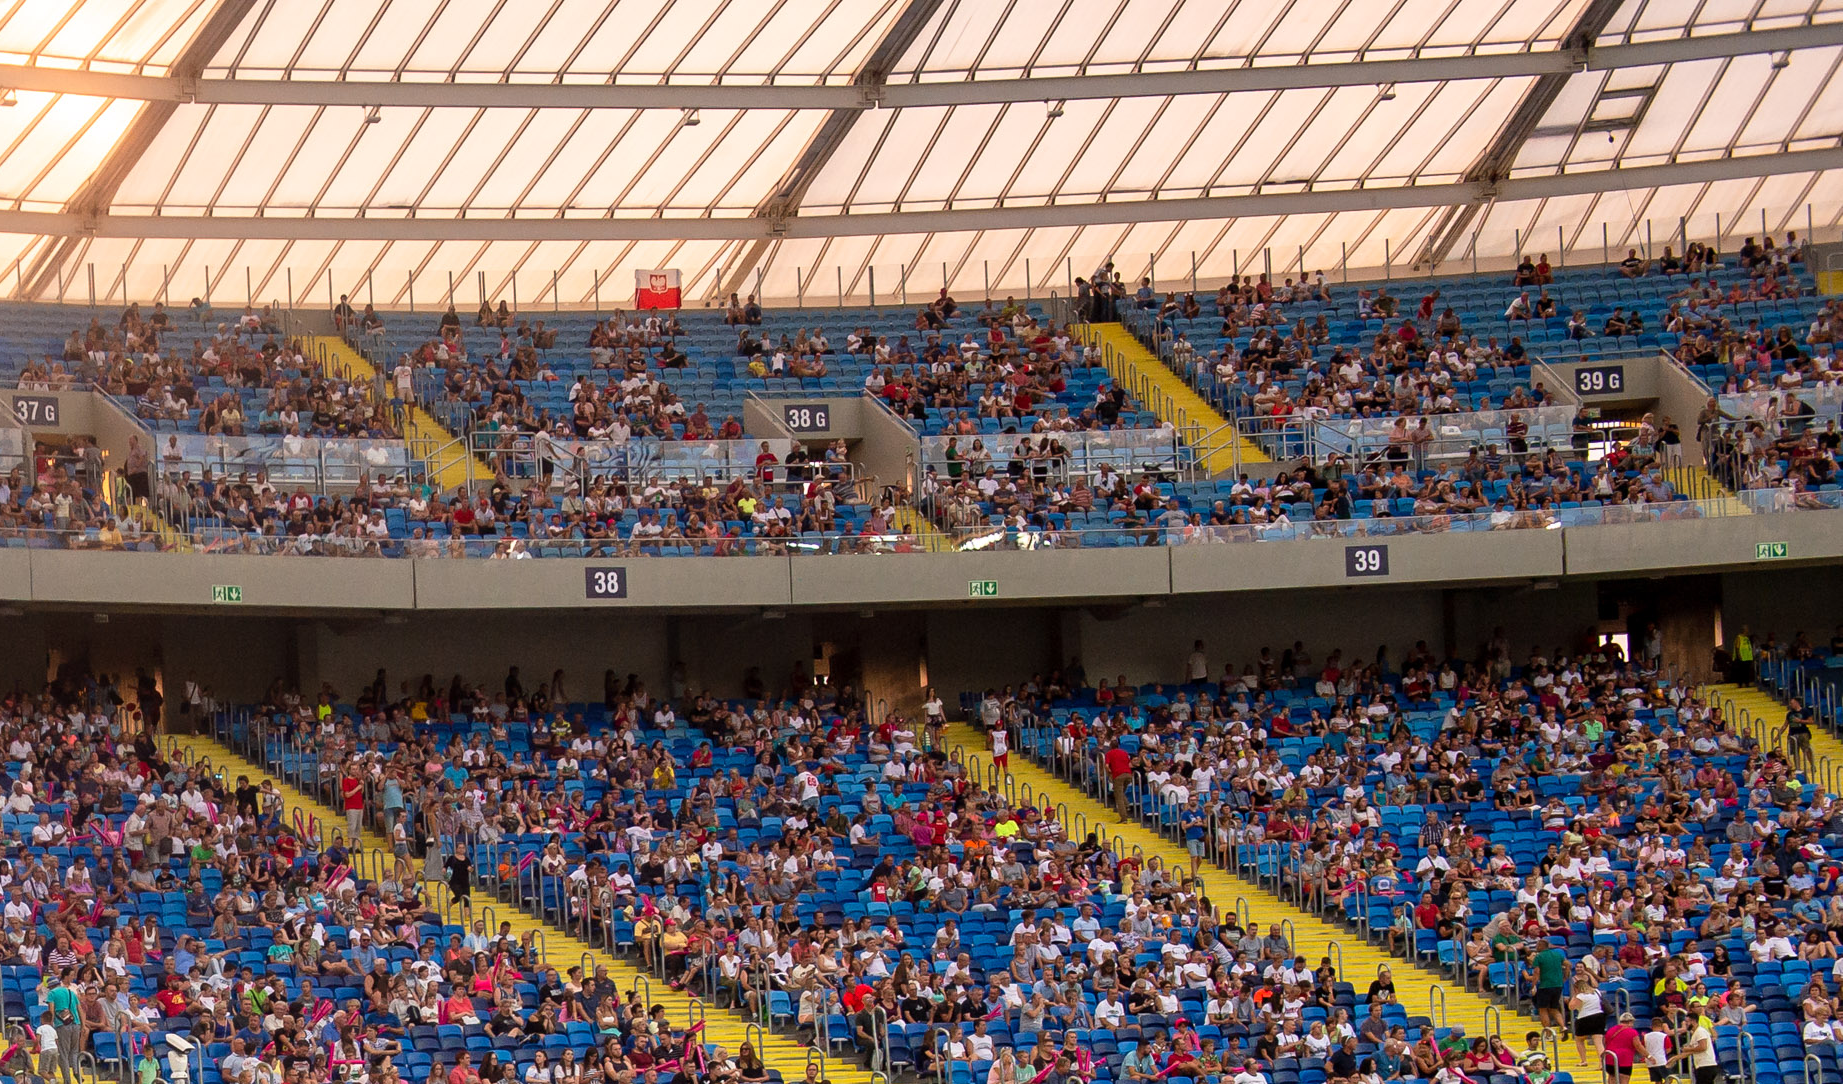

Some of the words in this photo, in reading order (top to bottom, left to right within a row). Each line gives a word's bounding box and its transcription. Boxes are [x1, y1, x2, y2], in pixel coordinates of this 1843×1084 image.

[1580, 371, 1604, 391] 39
[1609, 373, 1620, 389] G
[17, 400, 39, 421] 37
[44, 404, 55, 422] G
[788, 409, 811, 428] 38
[815, 411, 826, 427] G
[1354, 549, 1380, 572] 39
[594, 571, 619, 594] 38
